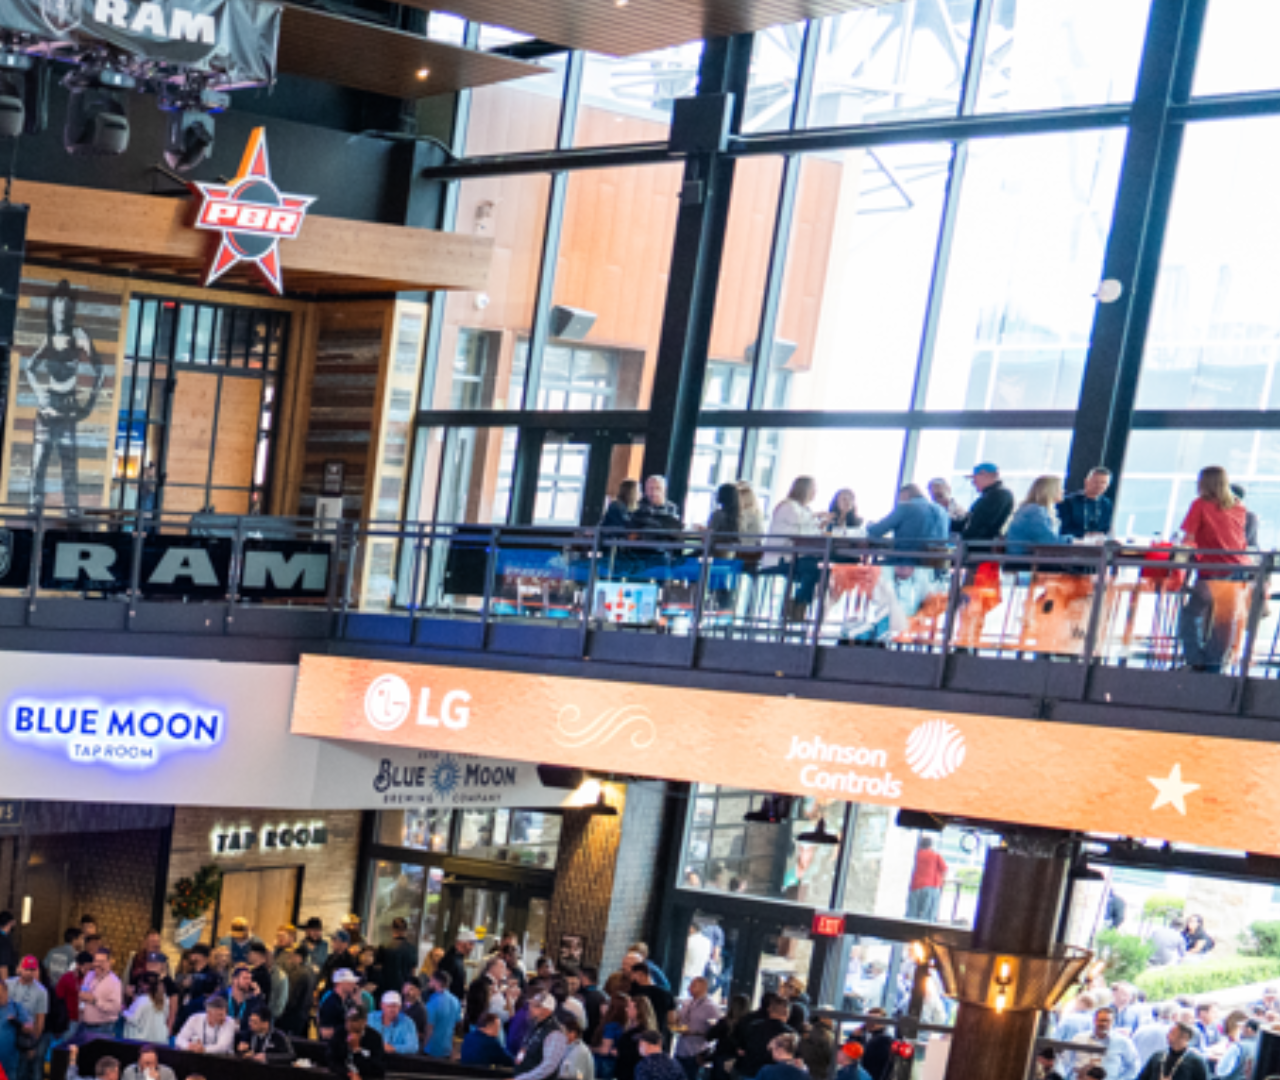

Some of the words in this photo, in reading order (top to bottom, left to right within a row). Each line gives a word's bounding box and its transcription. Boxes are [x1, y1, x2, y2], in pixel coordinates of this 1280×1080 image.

[94, 0, 216, 44] RAM
[205, 201, 298, 232] PBR
[52, 541, 328, 591] RAM
[15, 706, 99, 735] BLUE
[106, 709, 219, 742] MOON
[416, 690, 472, 729] LG
[73, 743, 102, 758] TAP
[104, 745, 154, 761] ROOM
[785, 735, 887, 768] Johnson
[373, 758, 428, 793] BLUE
[463, 762, 518, 788] MOON
[800, 764, 903, 798] Controls
